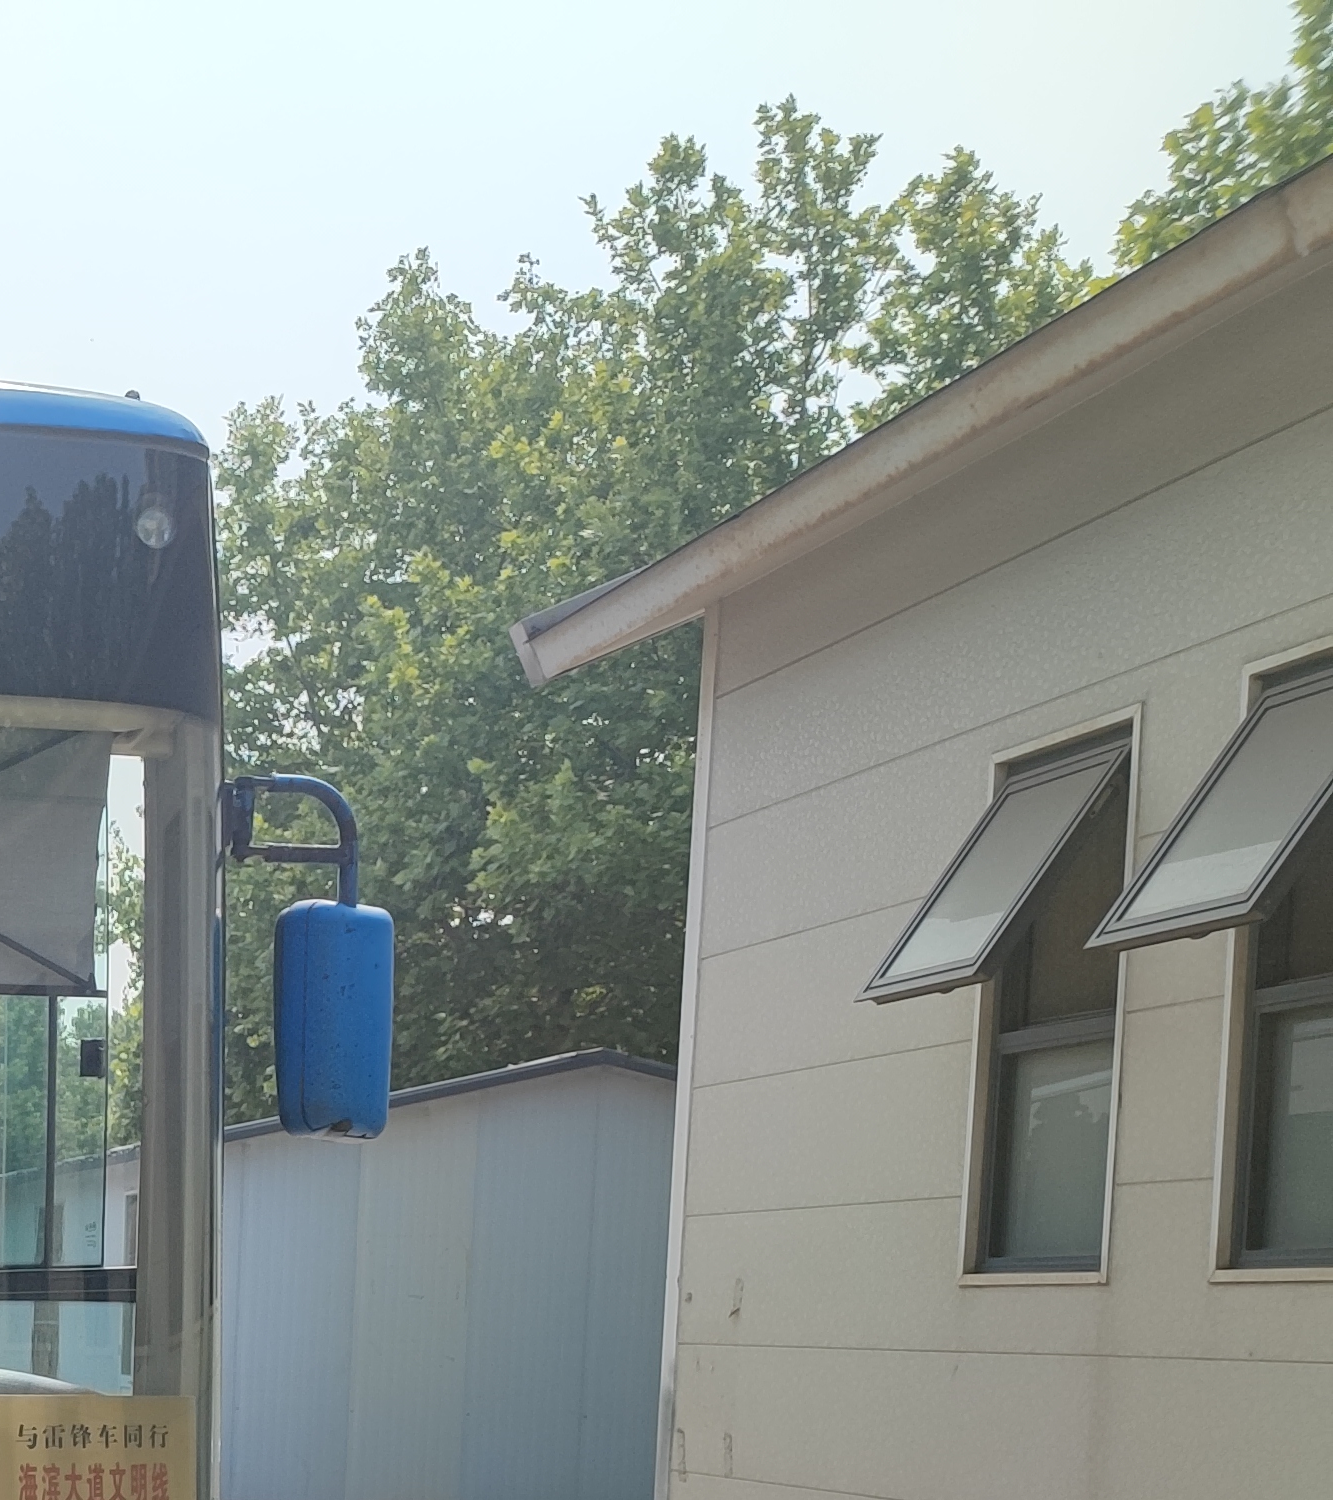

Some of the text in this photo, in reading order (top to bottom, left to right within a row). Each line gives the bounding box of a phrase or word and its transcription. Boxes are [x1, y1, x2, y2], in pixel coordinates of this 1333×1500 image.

[15, 1423, 171, 1450] 与雷锋车同行
